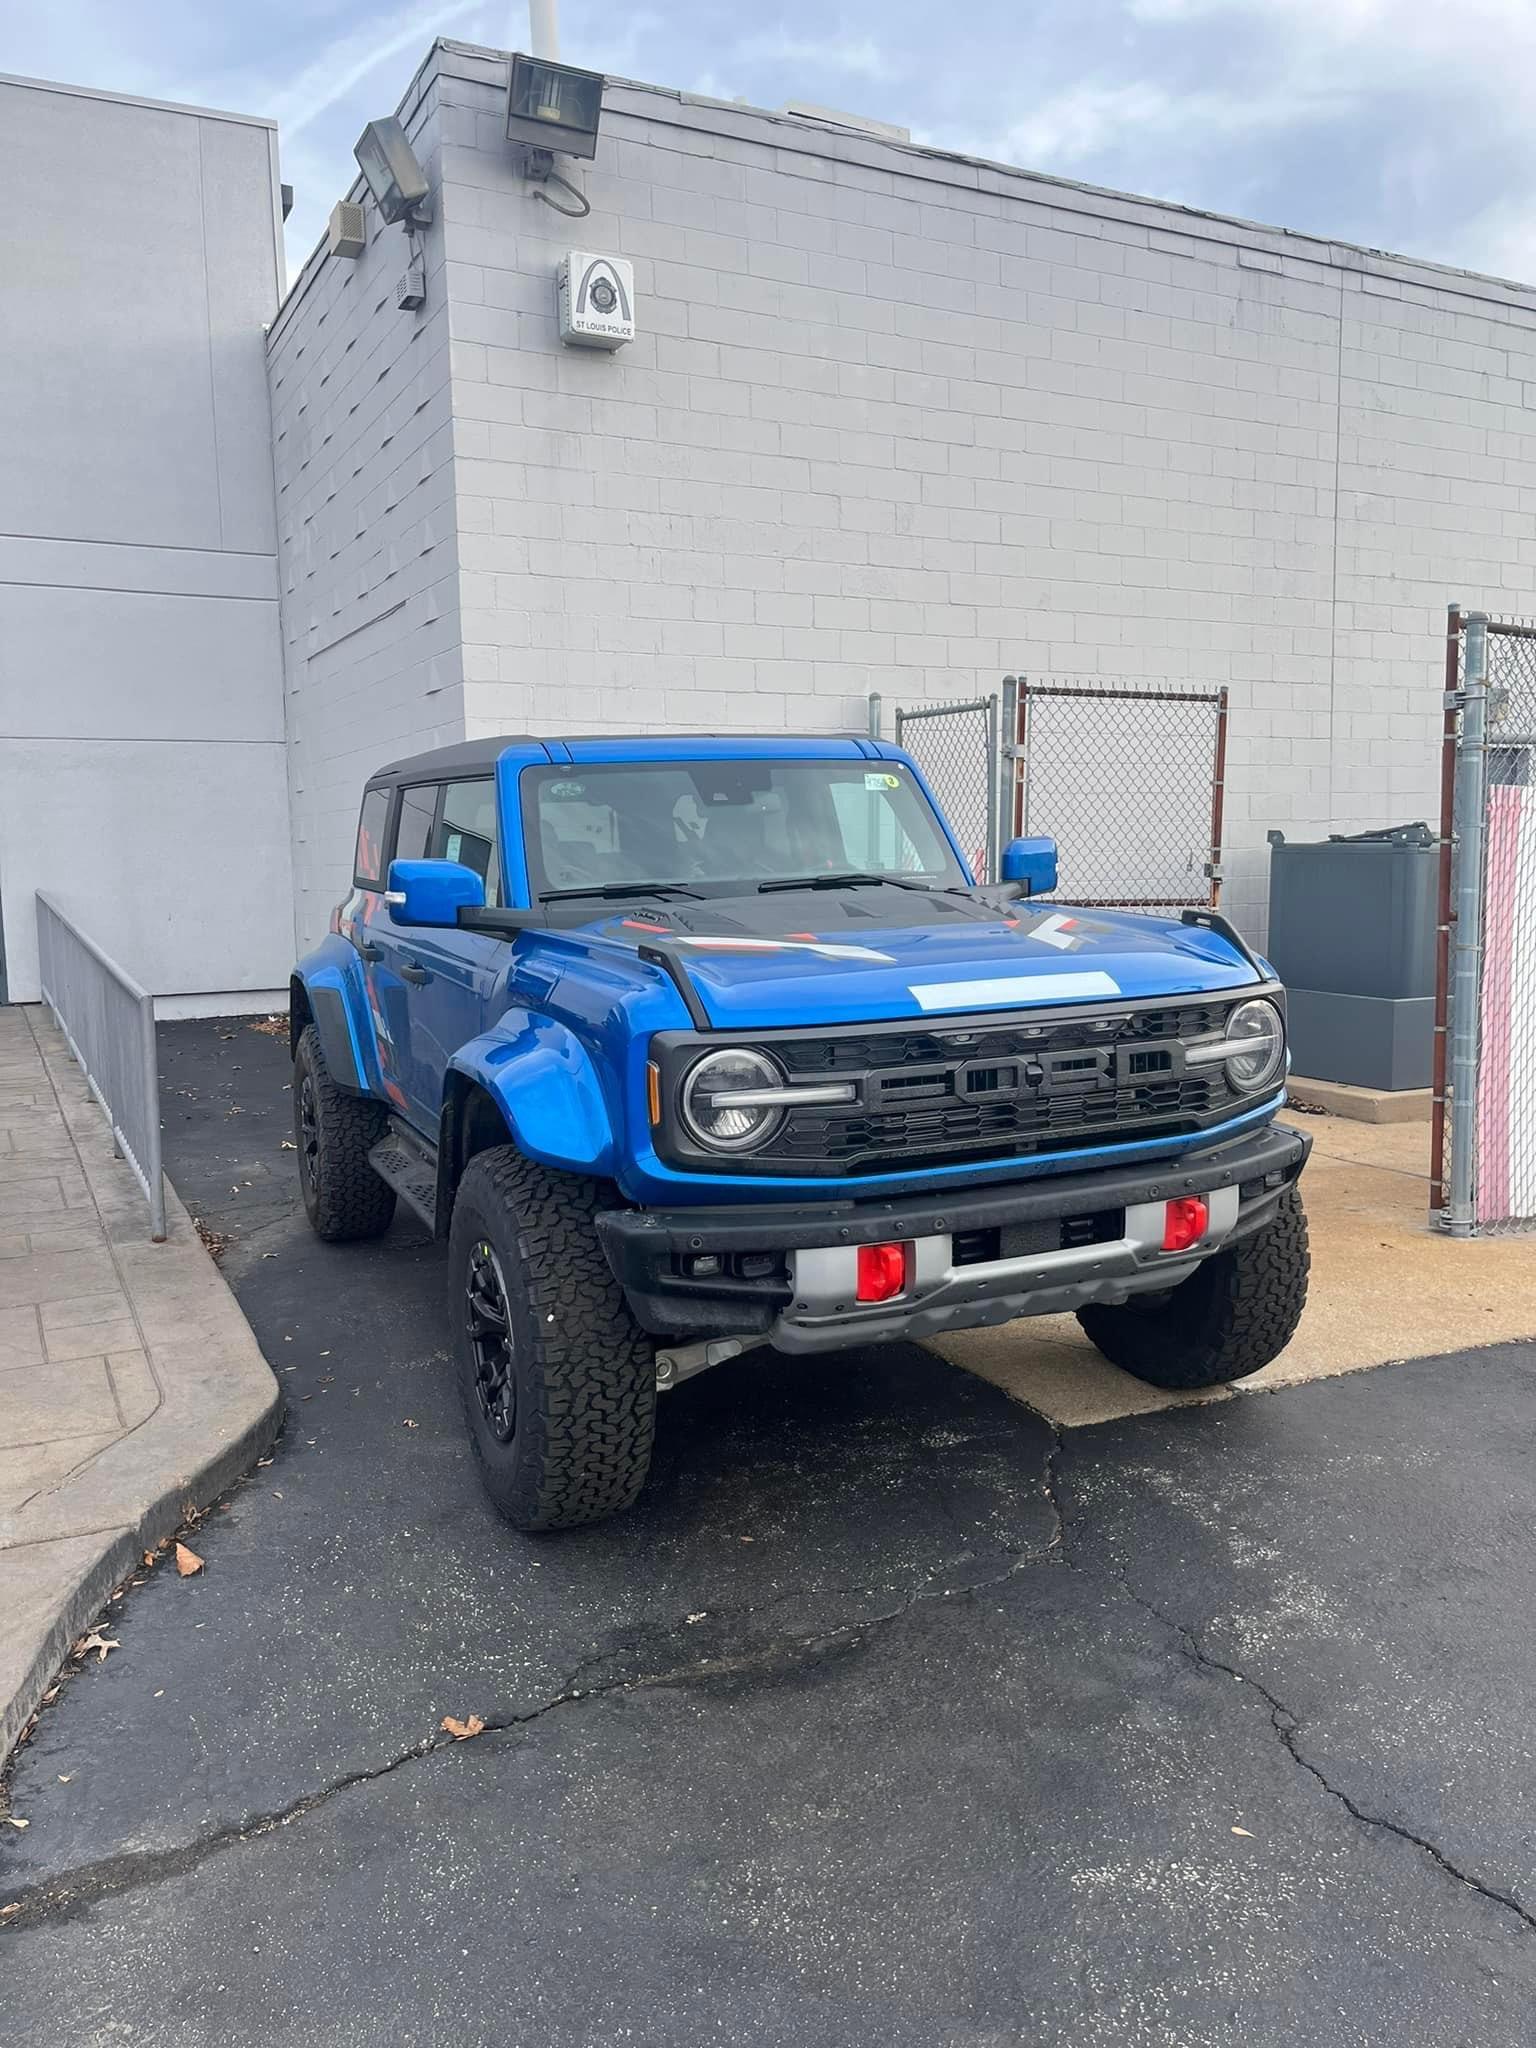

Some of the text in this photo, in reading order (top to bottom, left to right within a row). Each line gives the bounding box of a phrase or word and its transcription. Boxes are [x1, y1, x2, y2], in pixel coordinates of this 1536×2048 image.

[576, 320, 632, 336] ST LOUIS POLICE
[866, 1038, 1185, 1112] FORD
